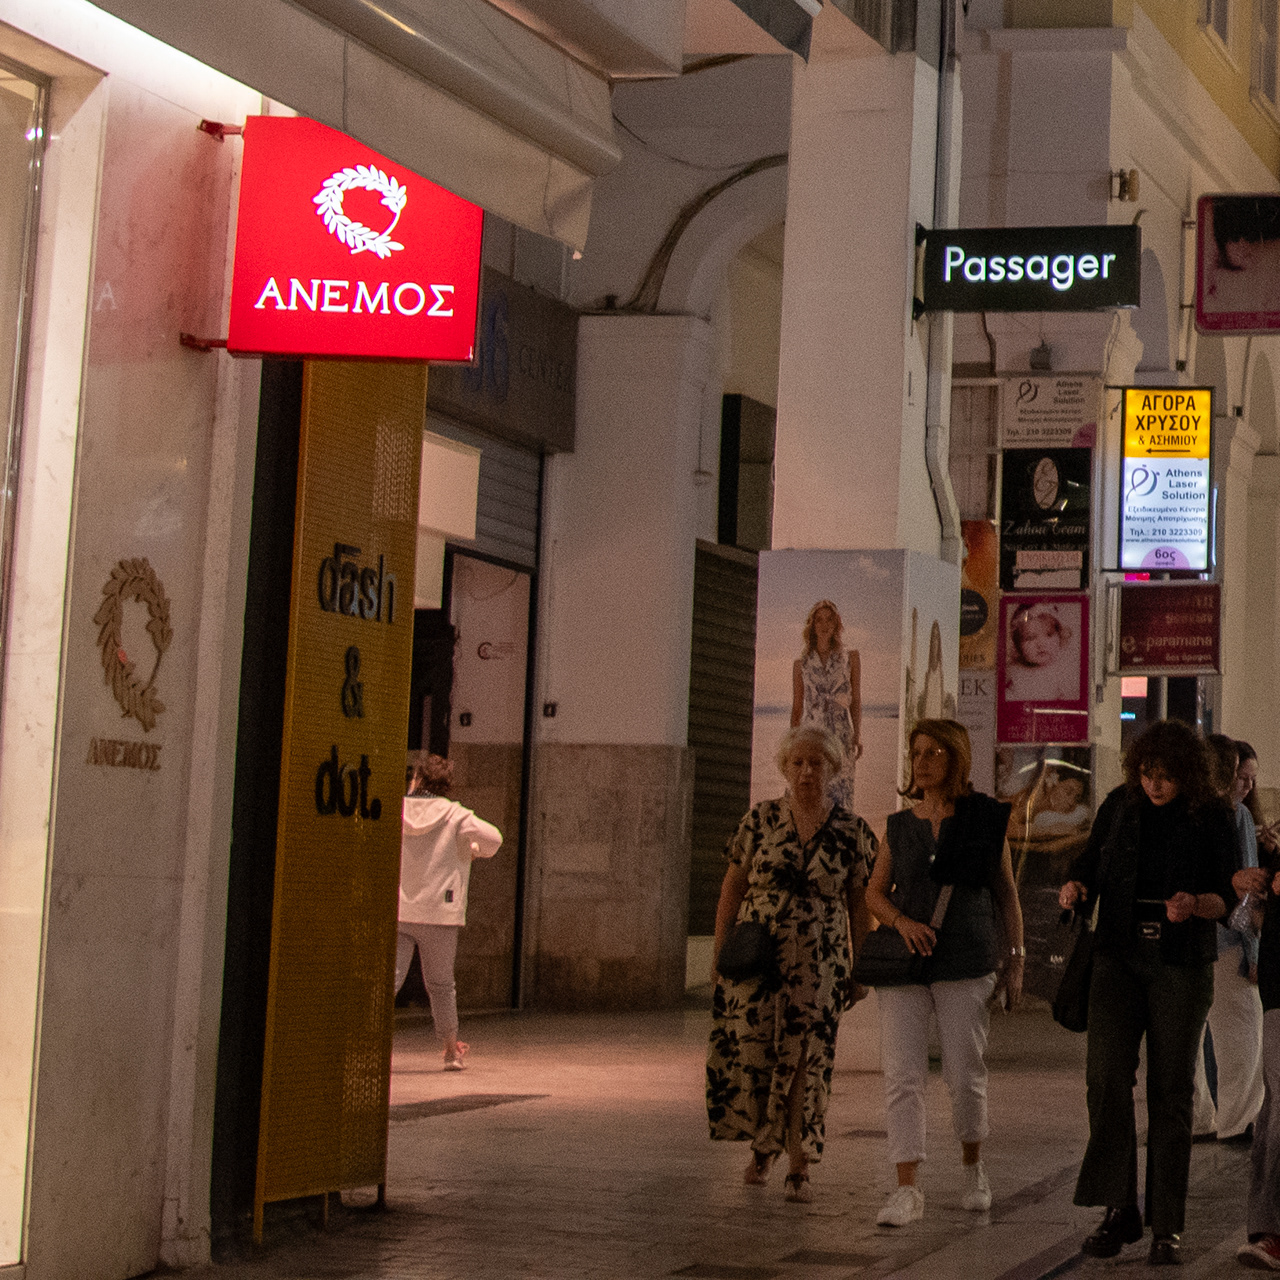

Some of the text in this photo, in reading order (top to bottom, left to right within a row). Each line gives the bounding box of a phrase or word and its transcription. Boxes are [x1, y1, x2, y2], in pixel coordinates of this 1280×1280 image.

[942, 246, 1116, 291] Passager
[254, 277, 455, 317] ΑΝΕΜΟΣ
[1141, 395, 1196, 411] ΑΓΟΡΑ
[1135, 415, 1201, 431] ΧΡΥΣΟΥ
[1138, 435, 1198, 445] & ΑΣΗΜΙΟΥ
[1166, 469, 1202, 478] Athens
[1168, 480, 1197, 489] Laser
[1162, 491, 1205, 500] Solution
[1152, 528, 1167, 536] 210
[1169, 528, 1203, 536] 3223309
[1154, 549, 1176, 560] 6ος
[341, 646, 365, 720] &
[315, 745, 382, 821] dot.
